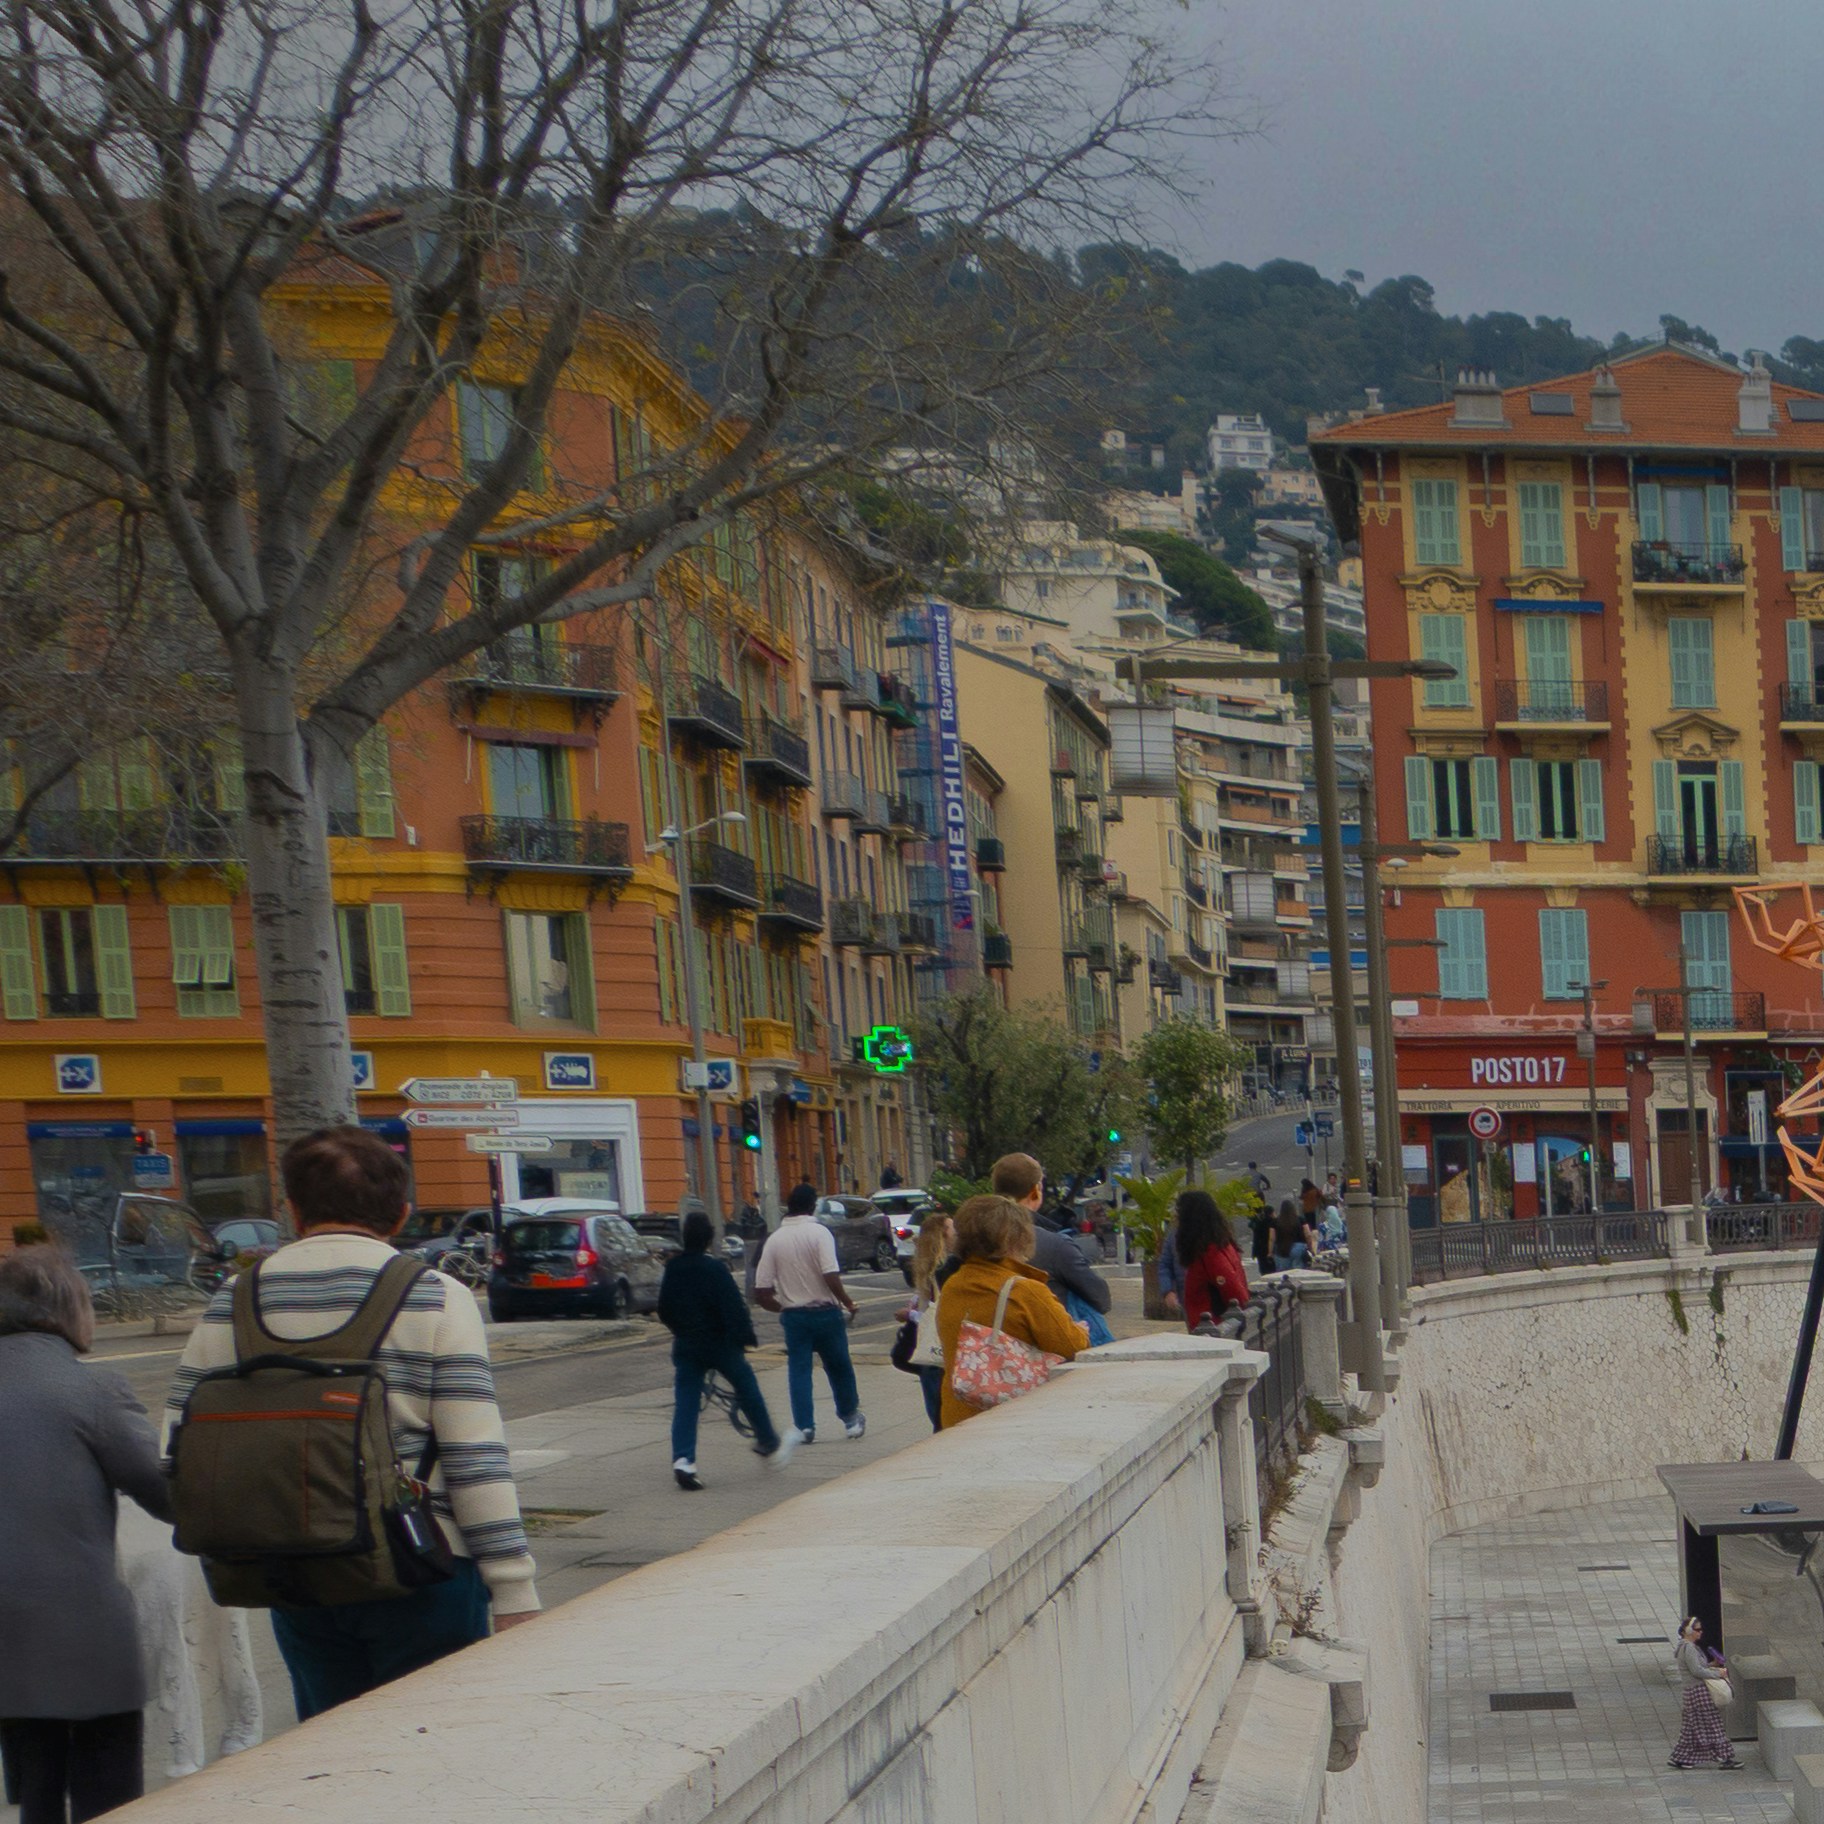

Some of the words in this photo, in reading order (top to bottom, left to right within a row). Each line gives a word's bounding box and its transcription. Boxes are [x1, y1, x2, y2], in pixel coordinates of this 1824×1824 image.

[934, 614, 953, 721] Ravalement
[942, 732, 967, 870] HEDHILI
[1406, 1101, 1453, 1111] TRATTORIA
